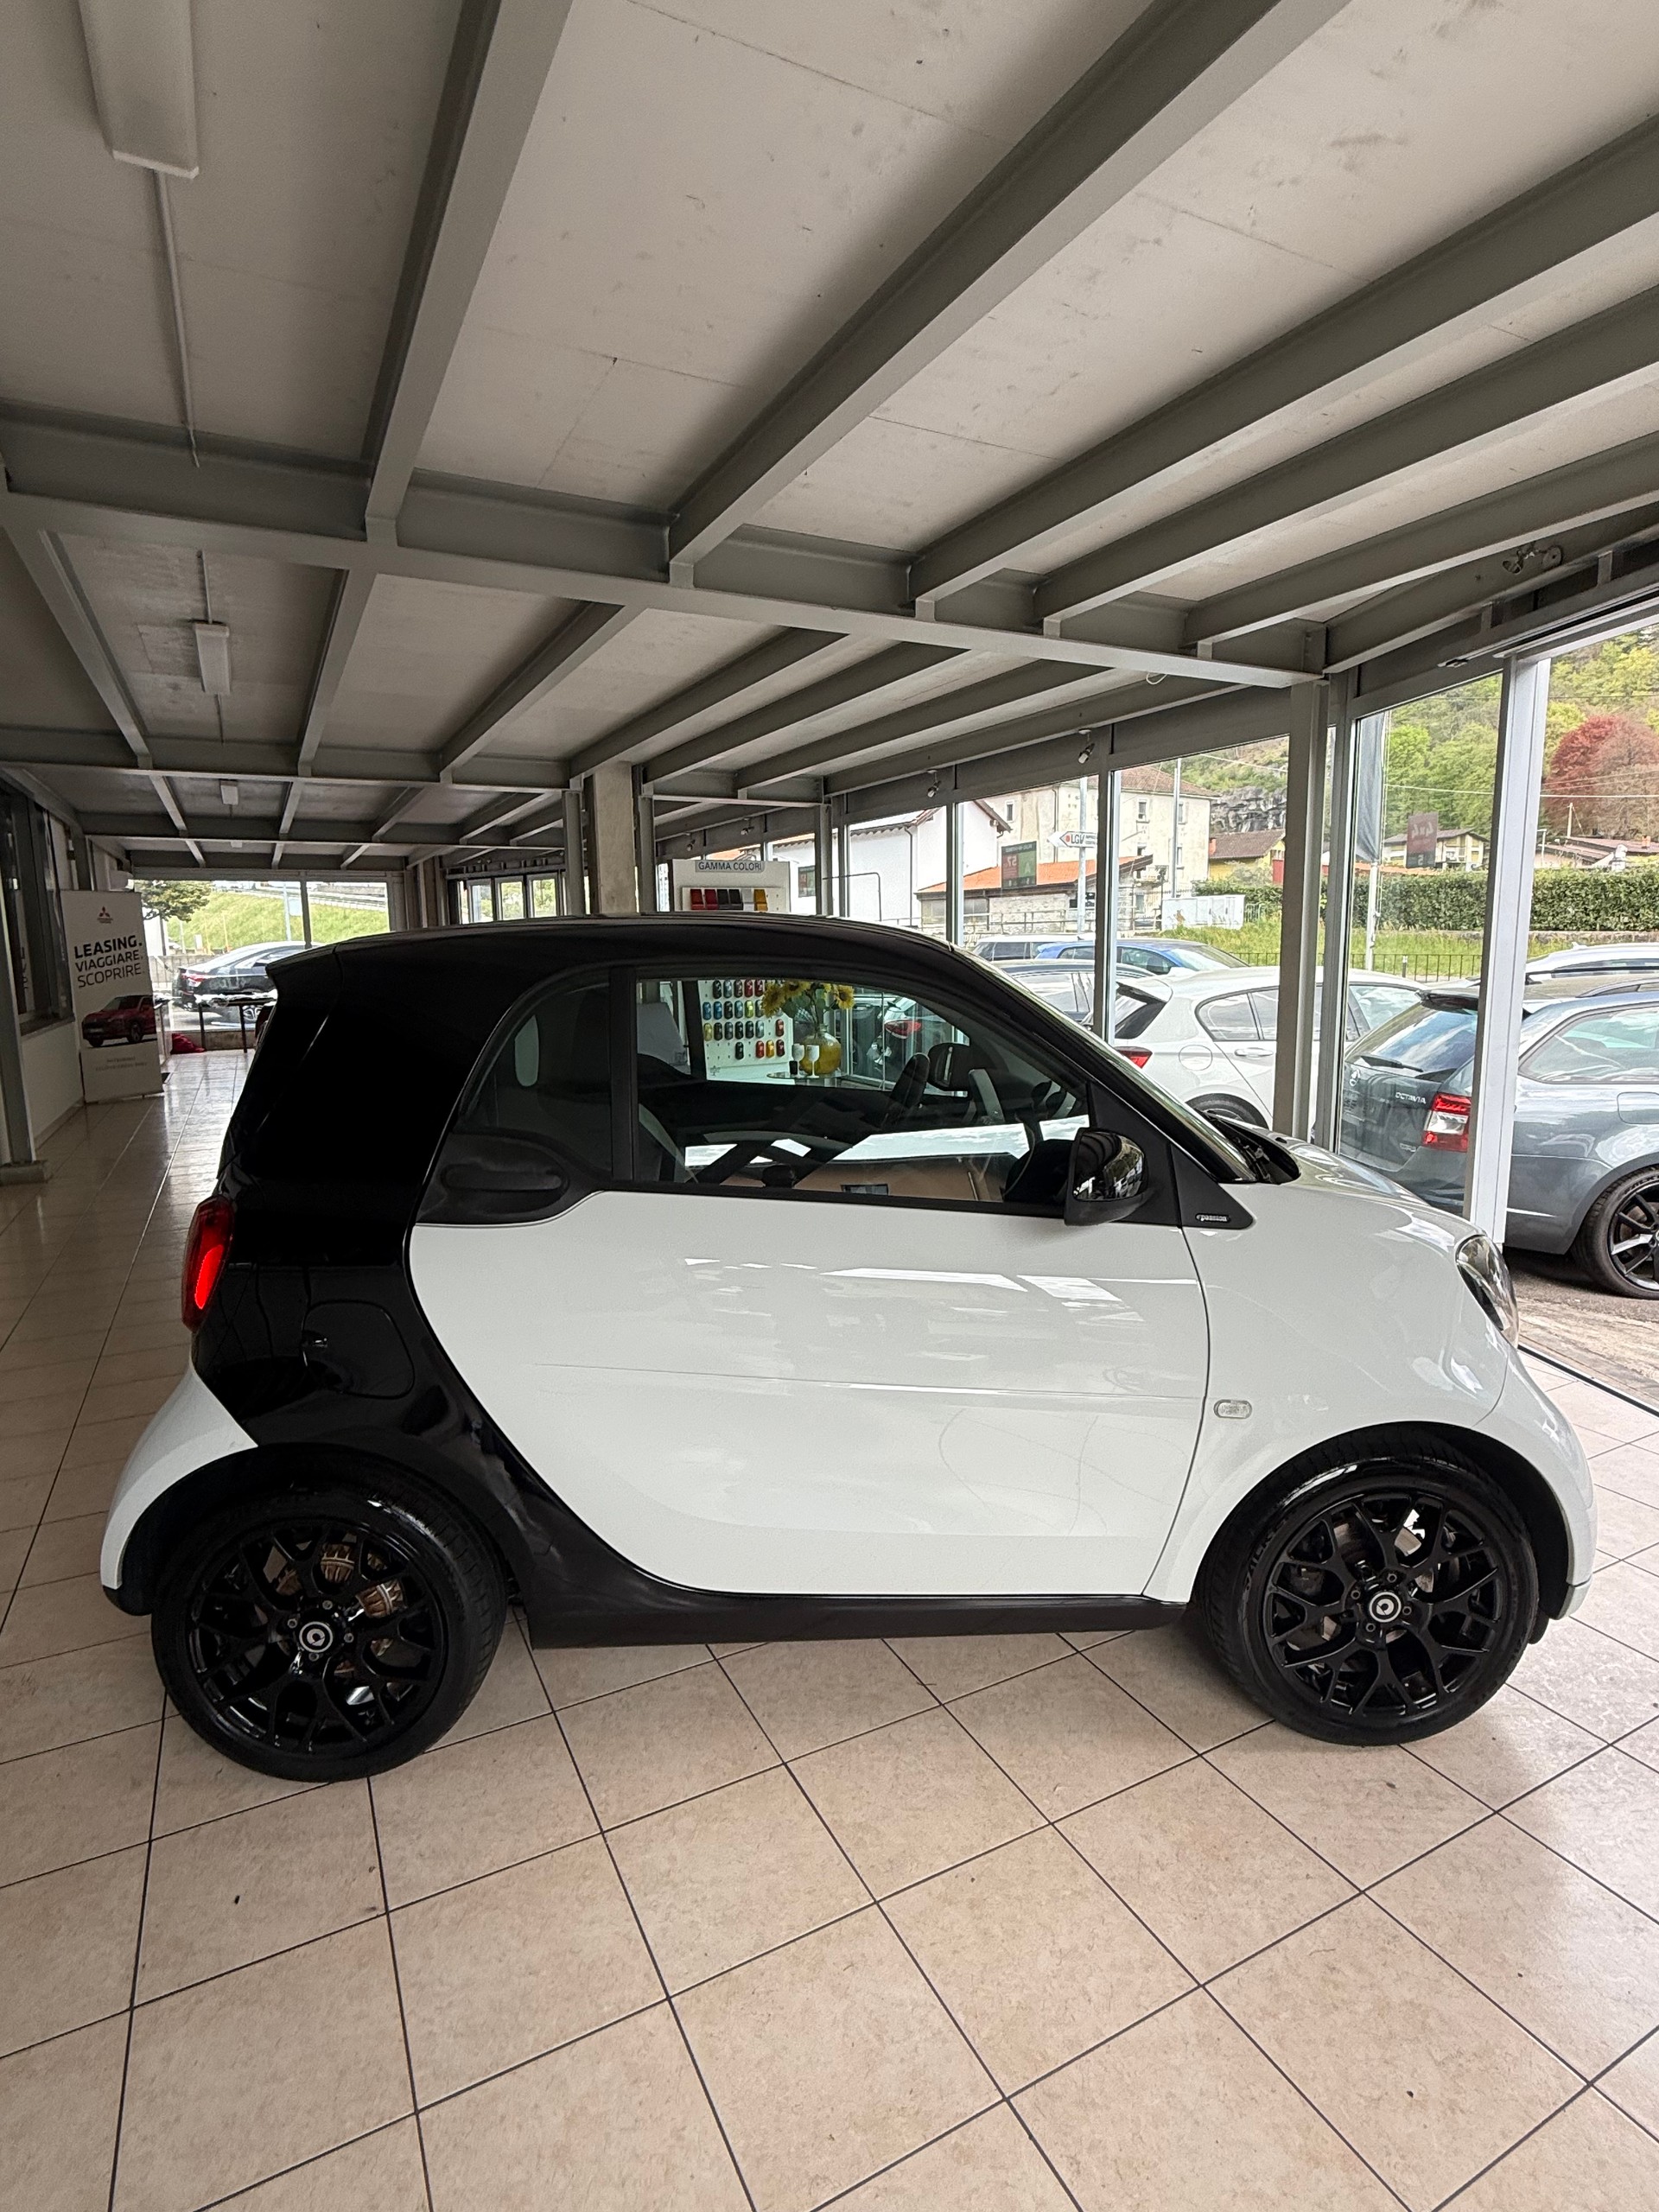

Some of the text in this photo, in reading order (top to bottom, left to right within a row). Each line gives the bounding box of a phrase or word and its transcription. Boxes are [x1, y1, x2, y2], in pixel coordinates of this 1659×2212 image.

[1071, 834, 1085, 844] LGV
[698, 861, 762, 871] GAMMA COLORI
[74, 935, 143, 959] LEASING.
[75, 950, 143, 972] VIAGGIARE.
[78, 963, 145, 988] SCOPRIRE.
[1395, 1091, 1427, 1104] OCTAVIA
